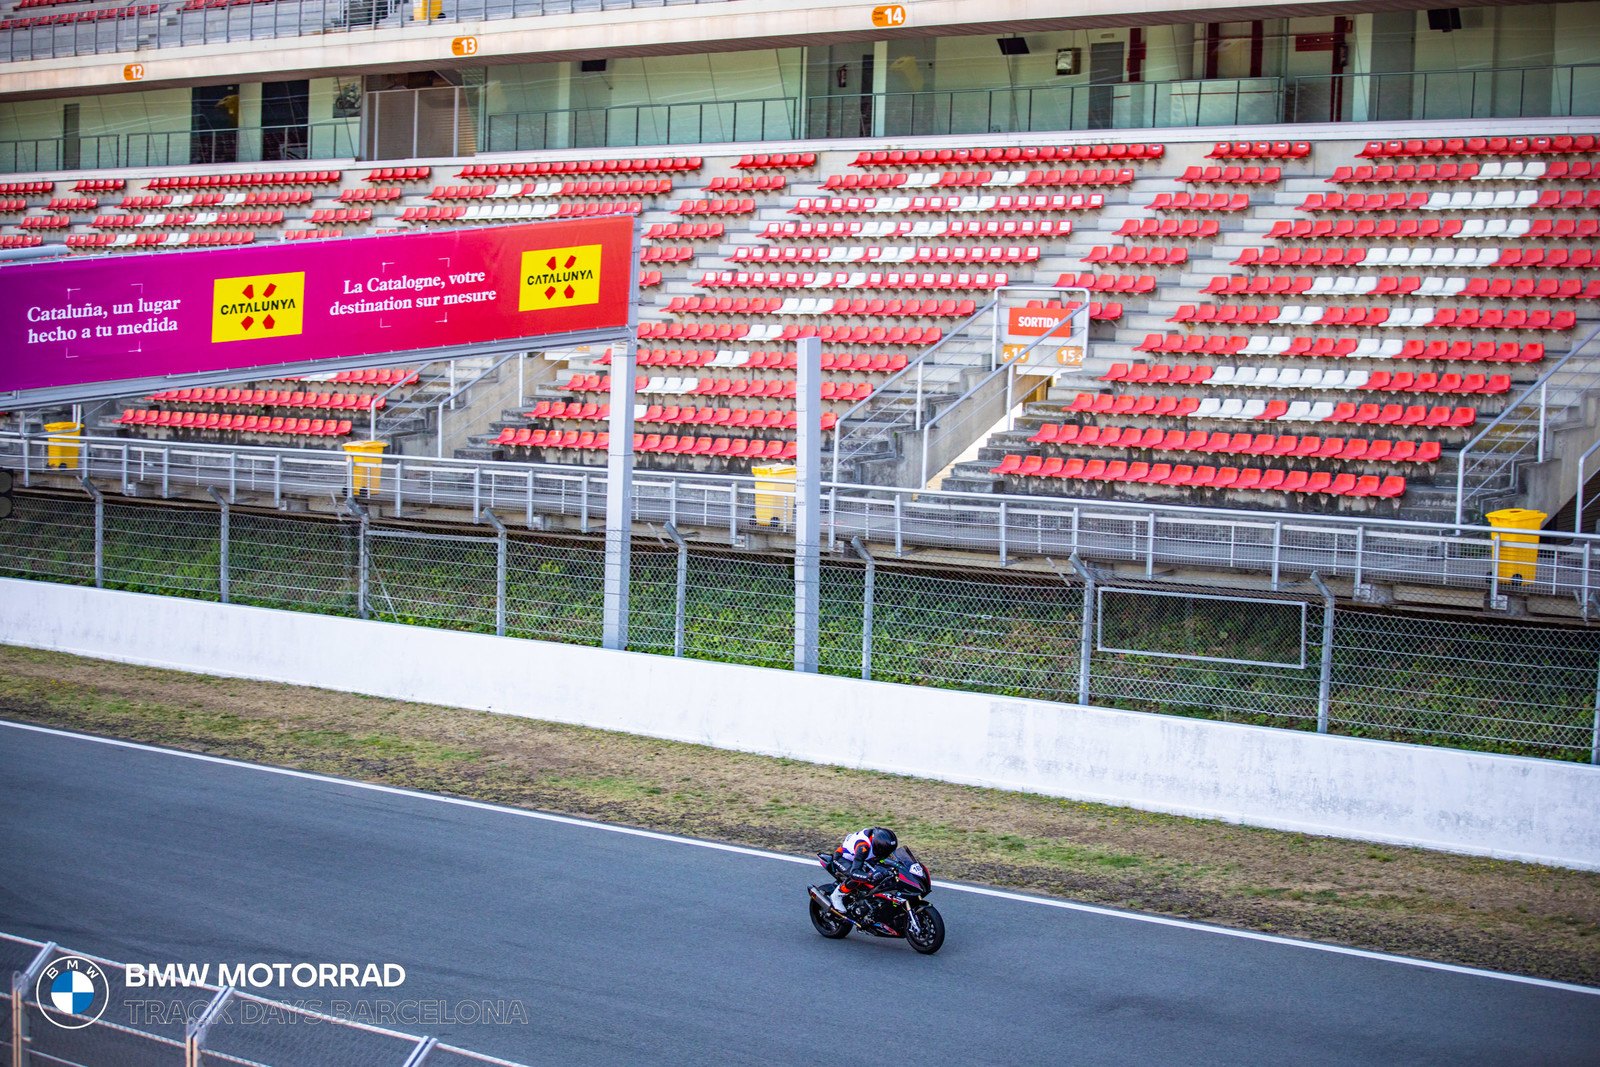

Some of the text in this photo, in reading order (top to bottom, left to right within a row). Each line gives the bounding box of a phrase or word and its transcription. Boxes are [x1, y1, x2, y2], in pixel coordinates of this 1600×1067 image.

[885, 7, 903, 24] 14
[461, 39, 475, 53] 13
[131, 65, 142, 79] 12
[343, 271, 485, 294] La Catalogne, votre
[527, 270, 593, 285] CATALUNYA
[27, 298, 181, 322] Cataluña, un lugar
[220, 299, 295, 315] CATALUNYA
[329, 290, 496, 315] destination sur mesure
[27, 317, 178, 343] hecho a tu medida
[1018, 316, 1060, 328] SORTIDA
[1061, 350, 1075, 362] 15
